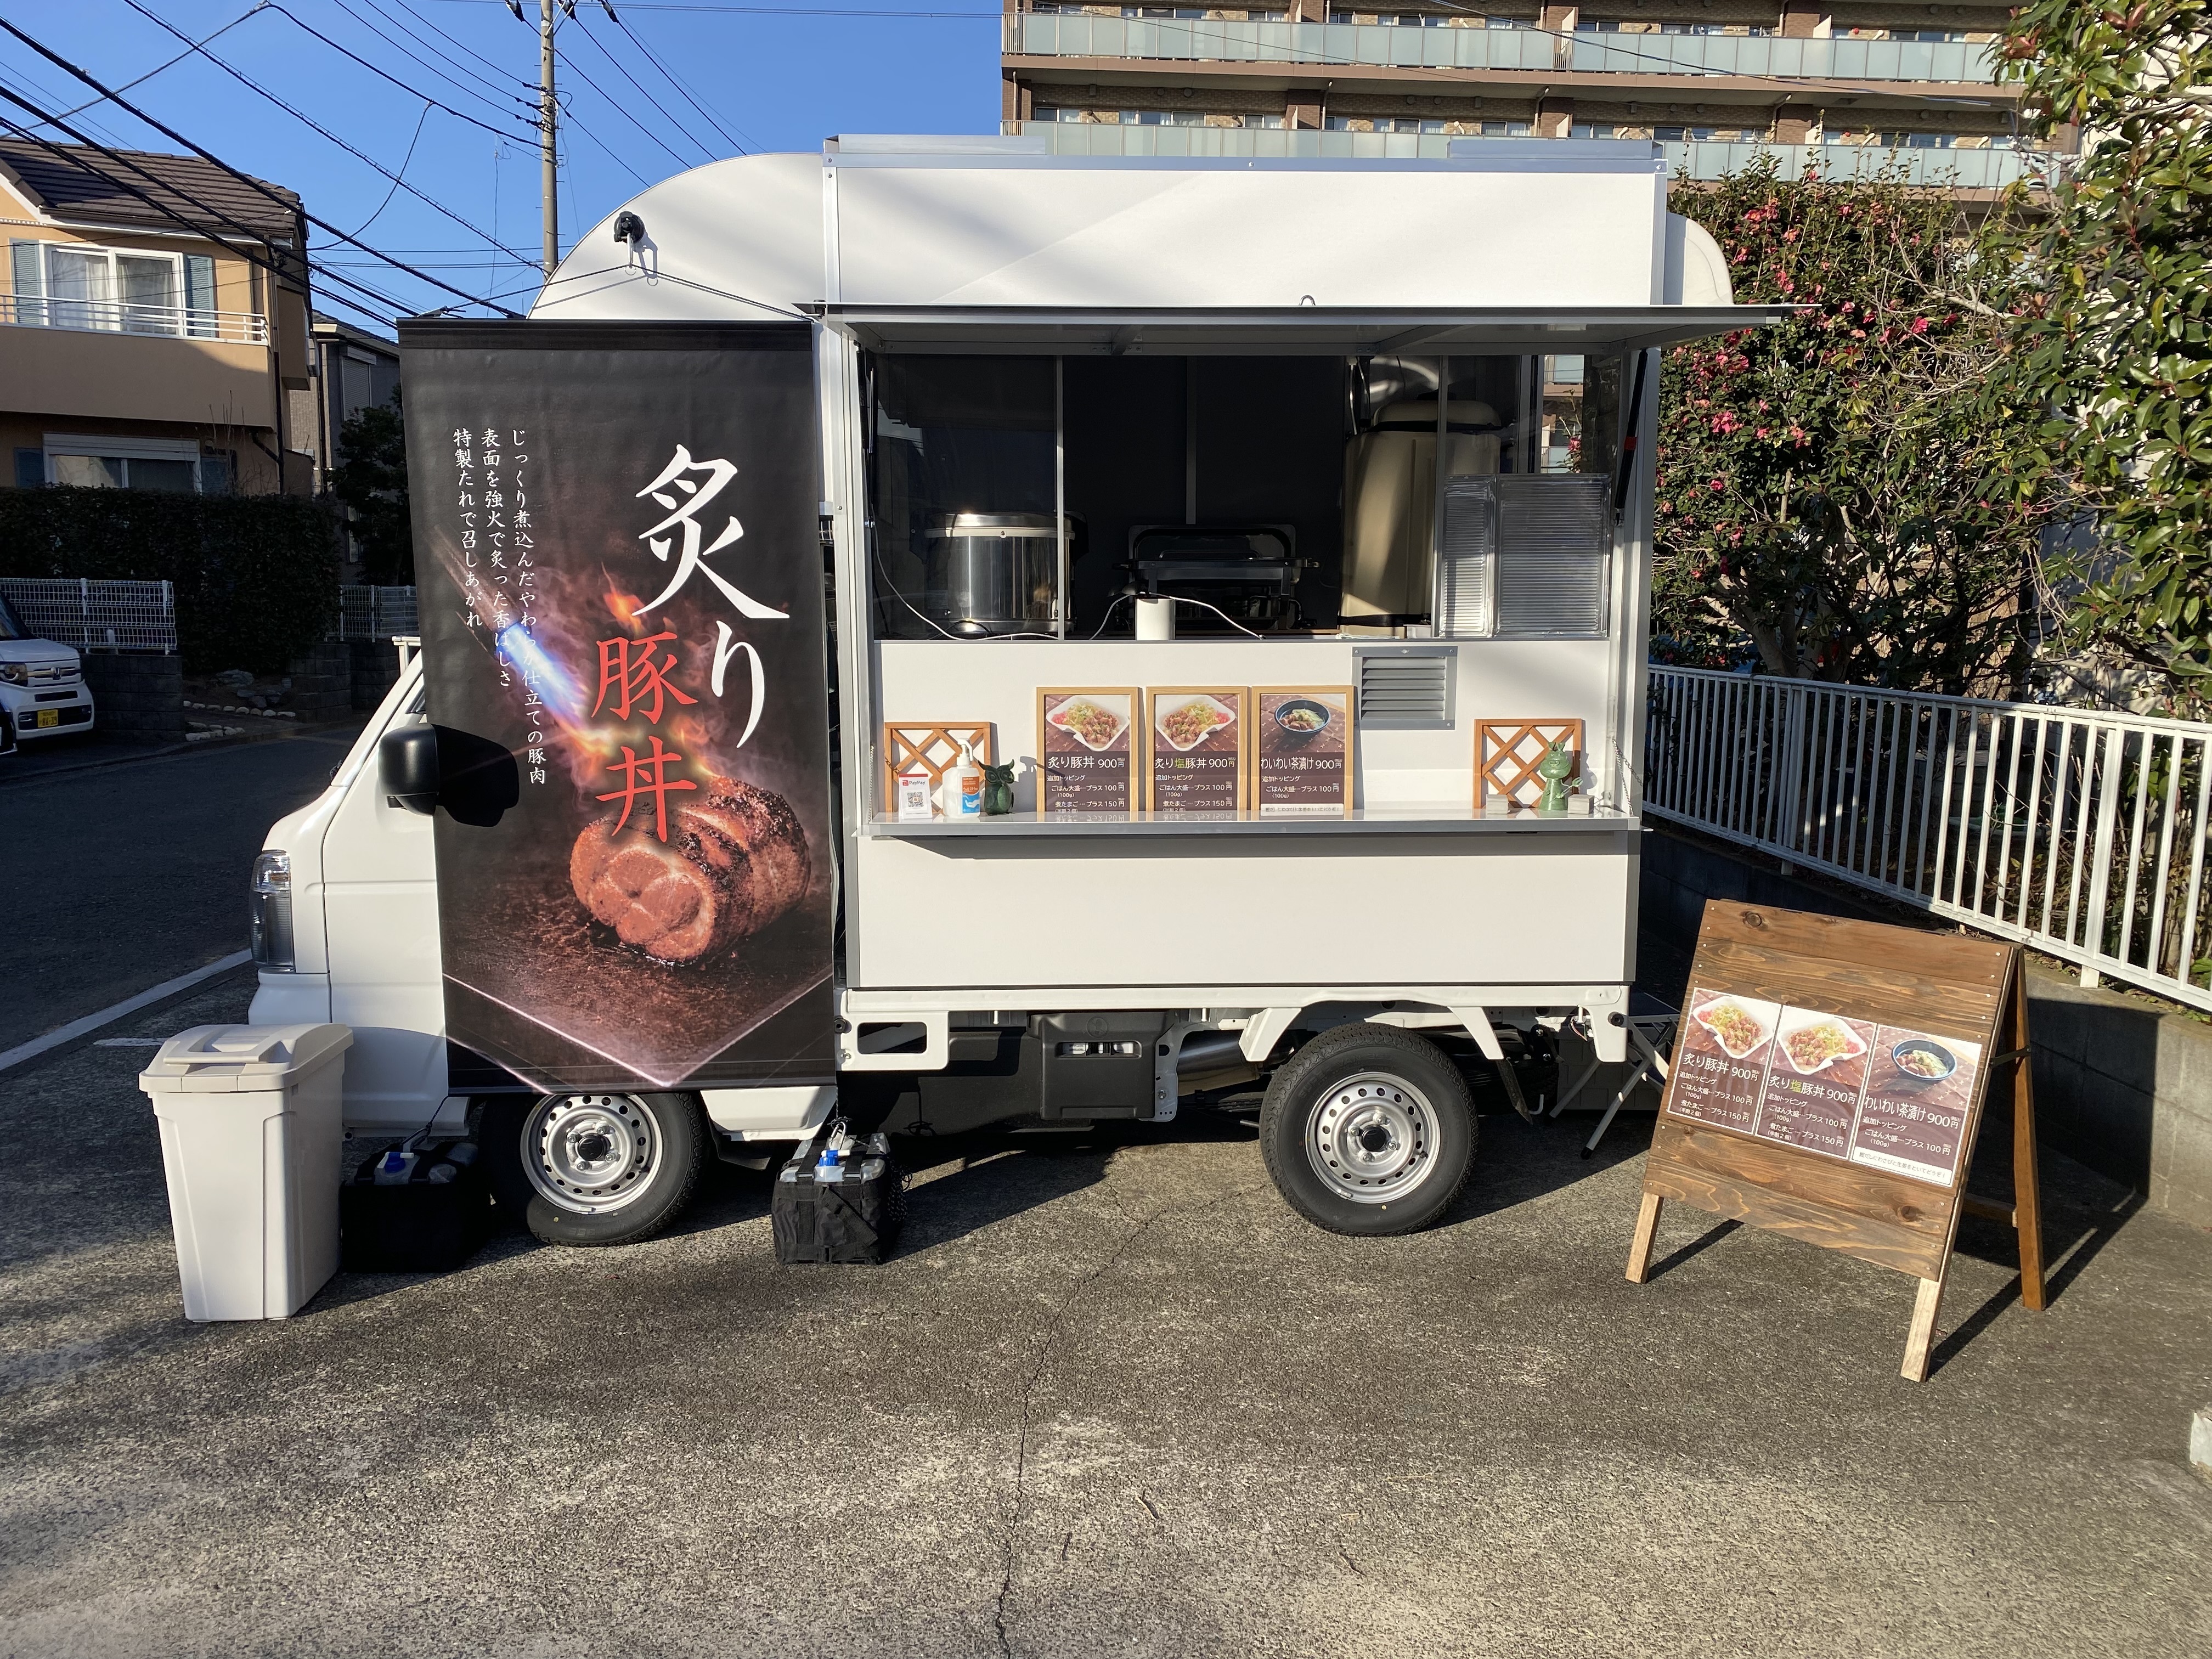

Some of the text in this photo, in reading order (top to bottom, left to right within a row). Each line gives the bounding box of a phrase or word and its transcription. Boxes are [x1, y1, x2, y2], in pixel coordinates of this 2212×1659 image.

[453, 427, 483, 627] 特製たれで召しあがれ
[481, 428, 511, 686] 表面を強火で炙った香ばしさ
[512, 429, 547, 785] じっくり煮込んだやわらか仕立ての豚肉
[591, 444, 790, 843] 炙り 豚丼
[1048, 756, 1124, 769] 炙り豚丼 900円
[1154, 758, 1207, 769] 炙り塩豚丼
[1260, 757, 1314, 770] わいわい茶漬け
[1683, 1053, 1729, 1074] 炙り豚丼
[1731, 1066, 1758, 1081] 900円
[1679, 1070, 1717, 1085] 追加トッピング
[1768, 1075, 1826, 1098] 炙り塩豚丼
[1714, 1091, 1730, 1100] プラス
[1767, 1092, 1808, 1107] 追加トッピング
[1711, 1108, 1727, 1117] プラス
[1864, 1094, 1926, 1122] わいわい茶漬け
[1805, 1114, 1824, 1124] プラス
[1862, 1115, 1908, 1132] 追加トッピング
[1802, 1130, 1819, 1141] プラス
[1905, 1138, 1924, 1149] プラス
